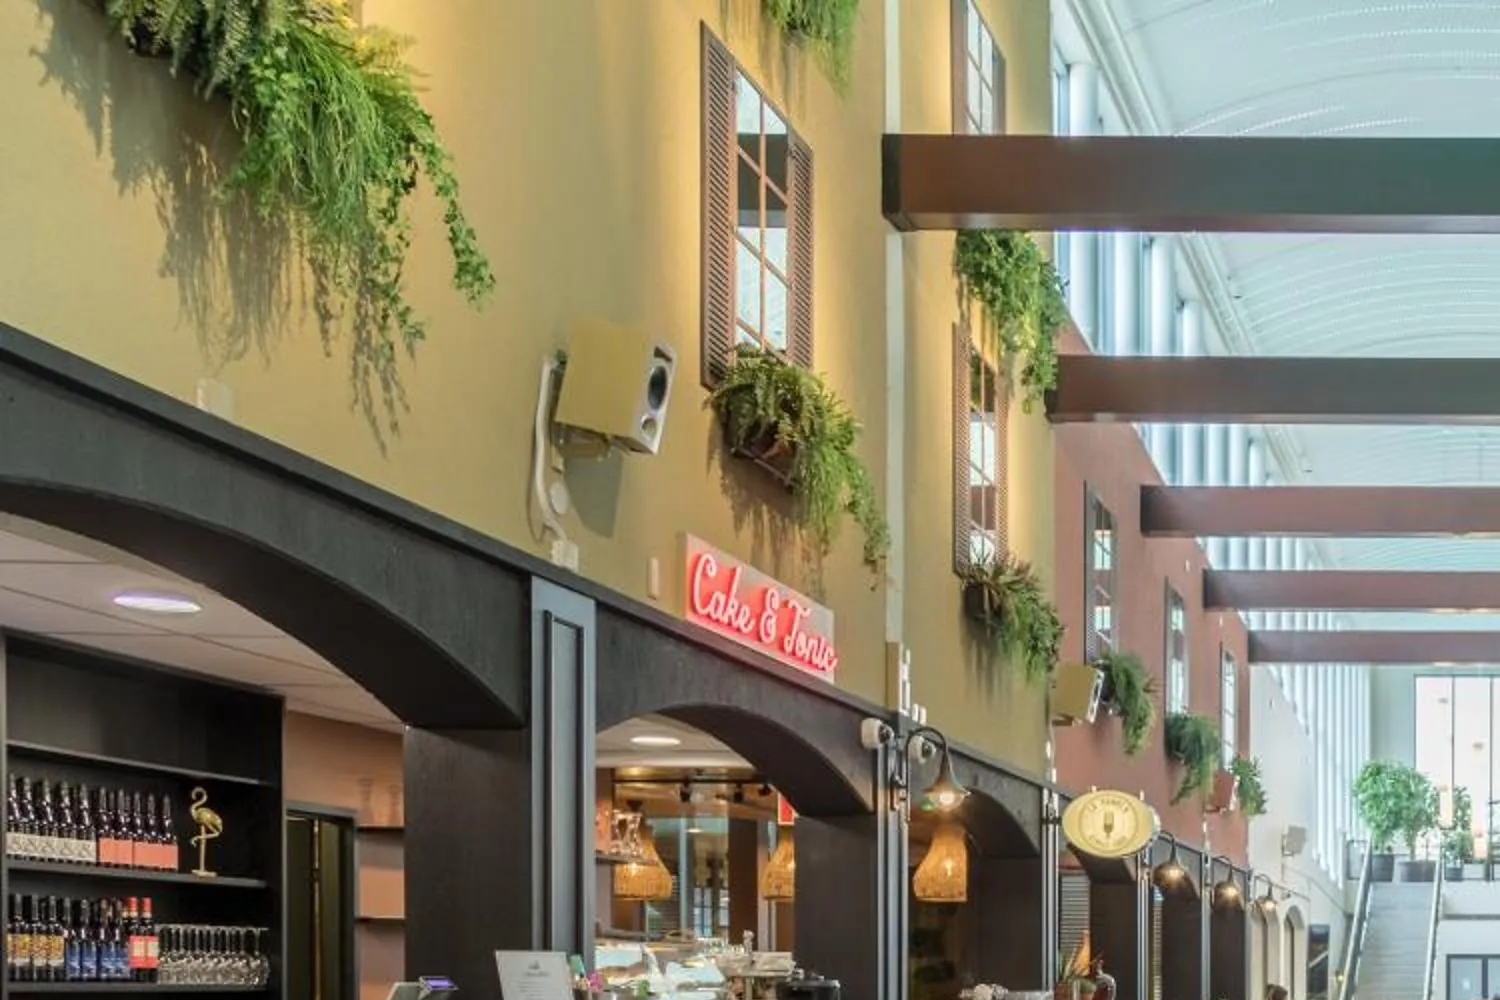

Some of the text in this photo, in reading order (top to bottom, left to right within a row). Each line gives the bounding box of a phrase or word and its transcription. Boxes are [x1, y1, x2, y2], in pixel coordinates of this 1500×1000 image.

[693, 553, 838, 673] Cake & Tonic
